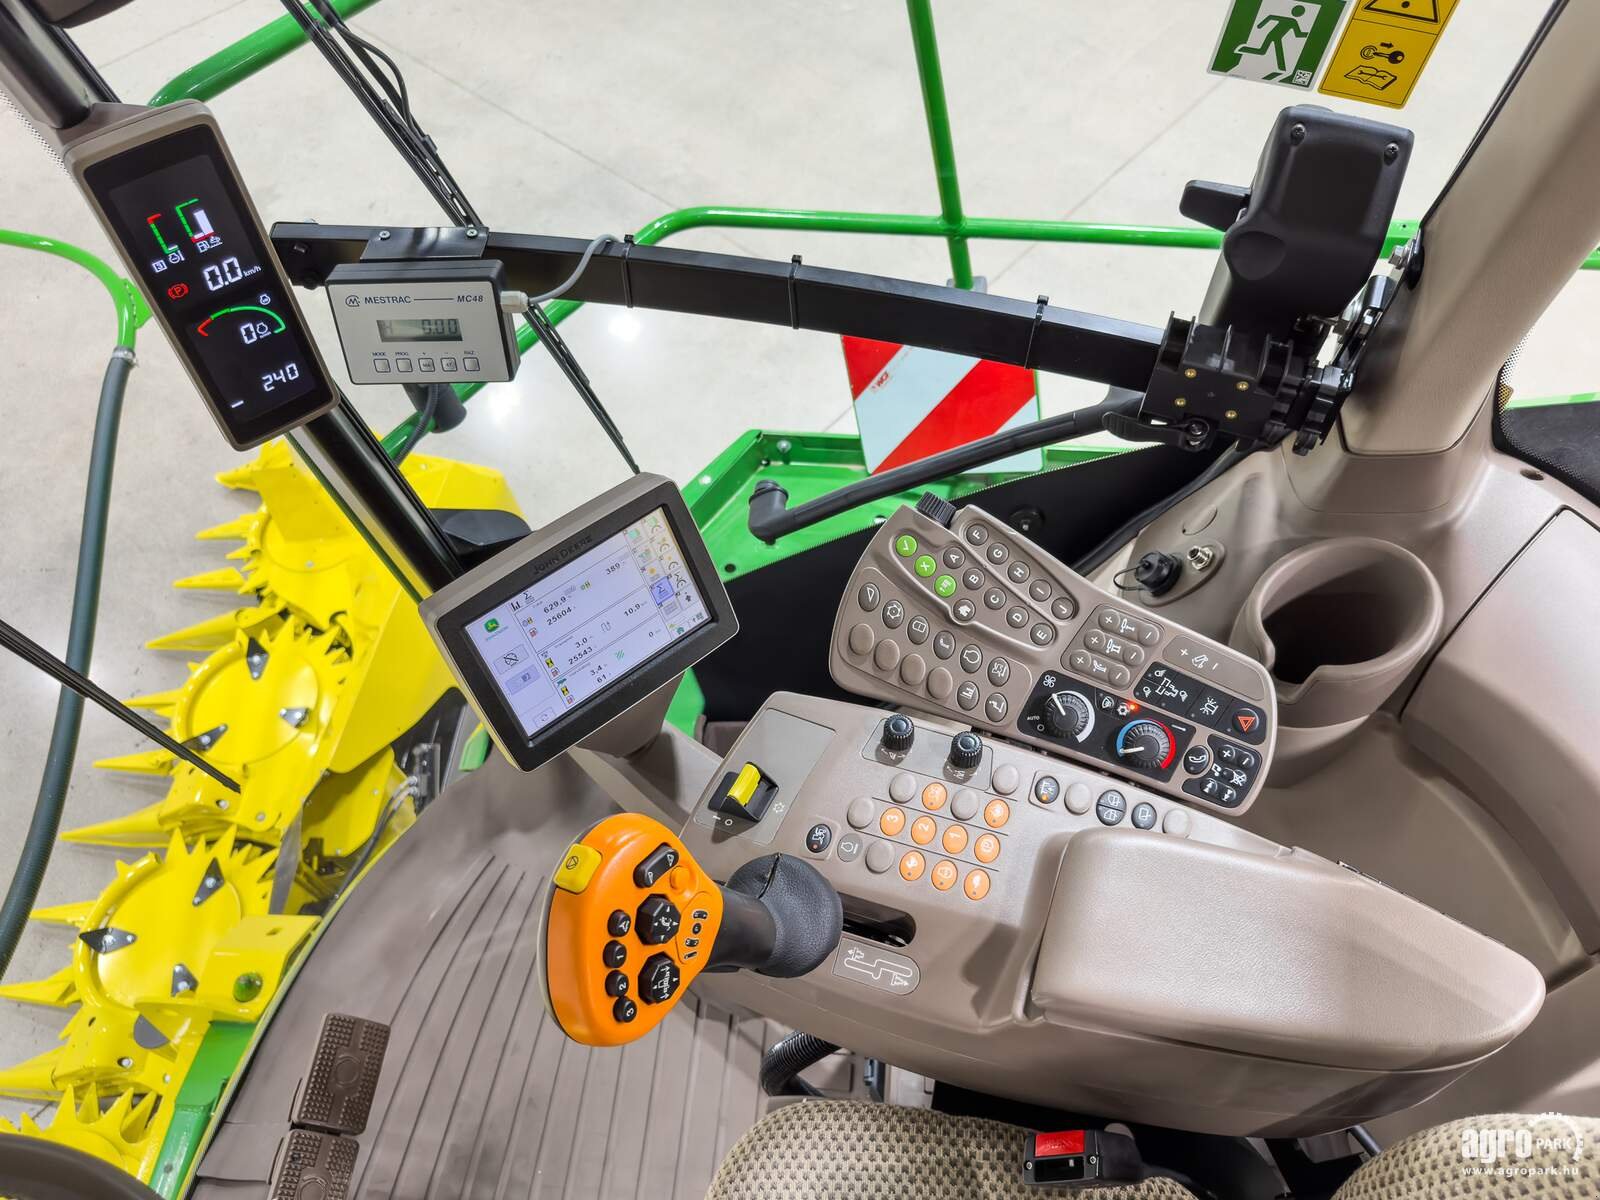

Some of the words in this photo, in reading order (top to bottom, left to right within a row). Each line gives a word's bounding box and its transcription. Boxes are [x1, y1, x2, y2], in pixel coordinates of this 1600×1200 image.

[202, 256, 243, 292] 0.0
[243, 265, 261, 277] km/h
[364, 295, 411, 305] MESTRAC
[457, 294, 484, 303] MC48
[239, 322, 258, 345] 0
[261, 362, 300, 393] 240
[973, 530, 982, 540] F
[533, 556, 559, 575] JOHN
[559, 536, 593, 558] DEERE
[949, 552, 960, 563] A
[993, 548, 1003, 558] G
[1014, 568, 1024, 577] H
[969, 574, 980, 584] B
[990, 594, 999, 603] C
[1058, 605, 1067, 614] J
[1012, 612, 1023, 622] D
[1036, 630, 1047, 640] E
[618, 981, 627, 990] 2
[625, 1007, 635, 1016] 3
